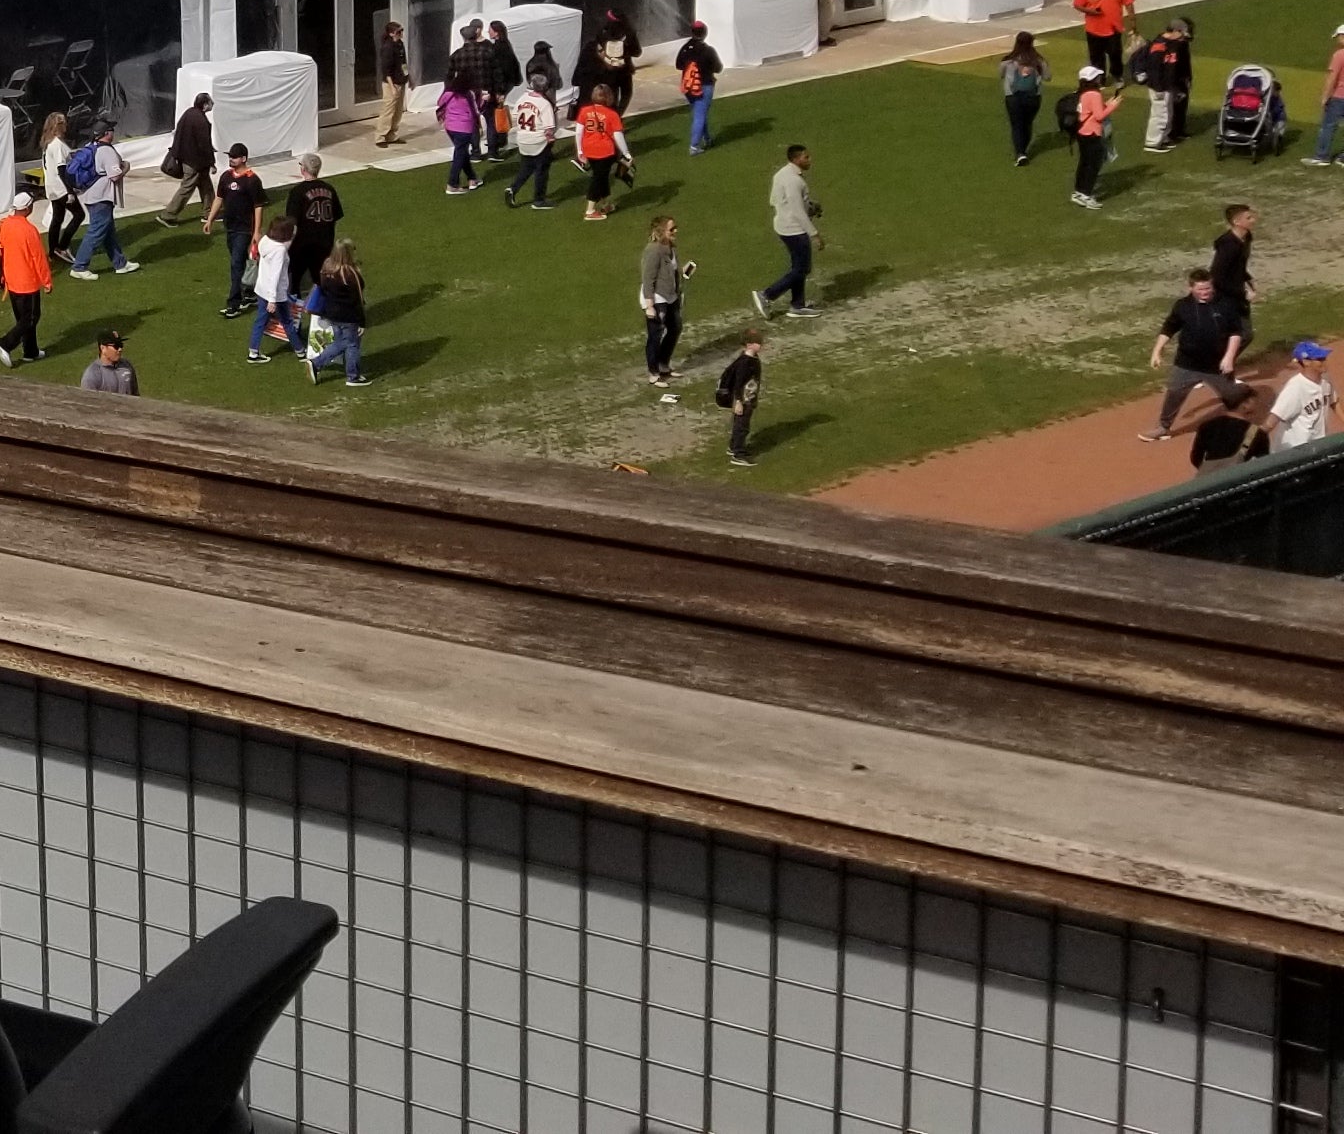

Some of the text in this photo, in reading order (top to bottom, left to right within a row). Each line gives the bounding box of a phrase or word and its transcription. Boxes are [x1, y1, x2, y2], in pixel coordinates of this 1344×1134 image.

[518, 112, 536, 132] 44
[585, 118, 606, 133] 28
[306, 200, 333, 222] 40
